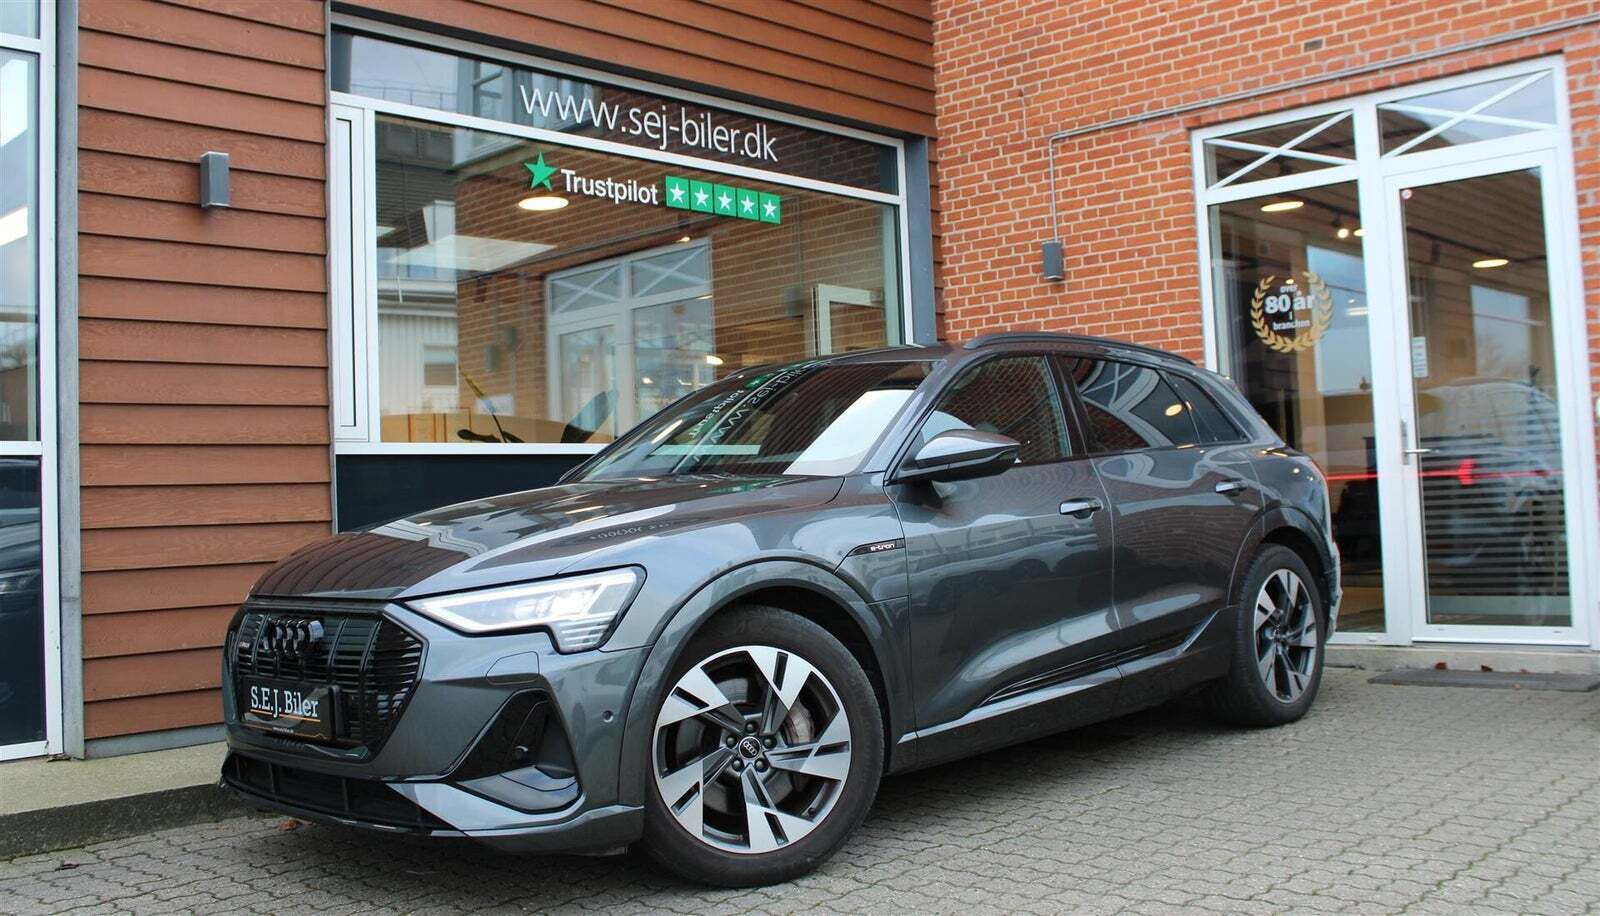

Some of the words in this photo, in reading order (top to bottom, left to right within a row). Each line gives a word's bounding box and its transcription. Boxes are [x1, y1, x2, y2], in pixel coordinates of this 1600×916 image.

[519, 84, 778, 162] www.sej-biler.dk
[561, 168, 659, 205] Trustpilot
[1264, 294, 1290, 314] 80
[1293, 290, 1315, 310] år
[870, 543, 894, 551] e-tron
[251, 685, 282, 718] S.E.J.
[285, 690, 318, 718] Biler
